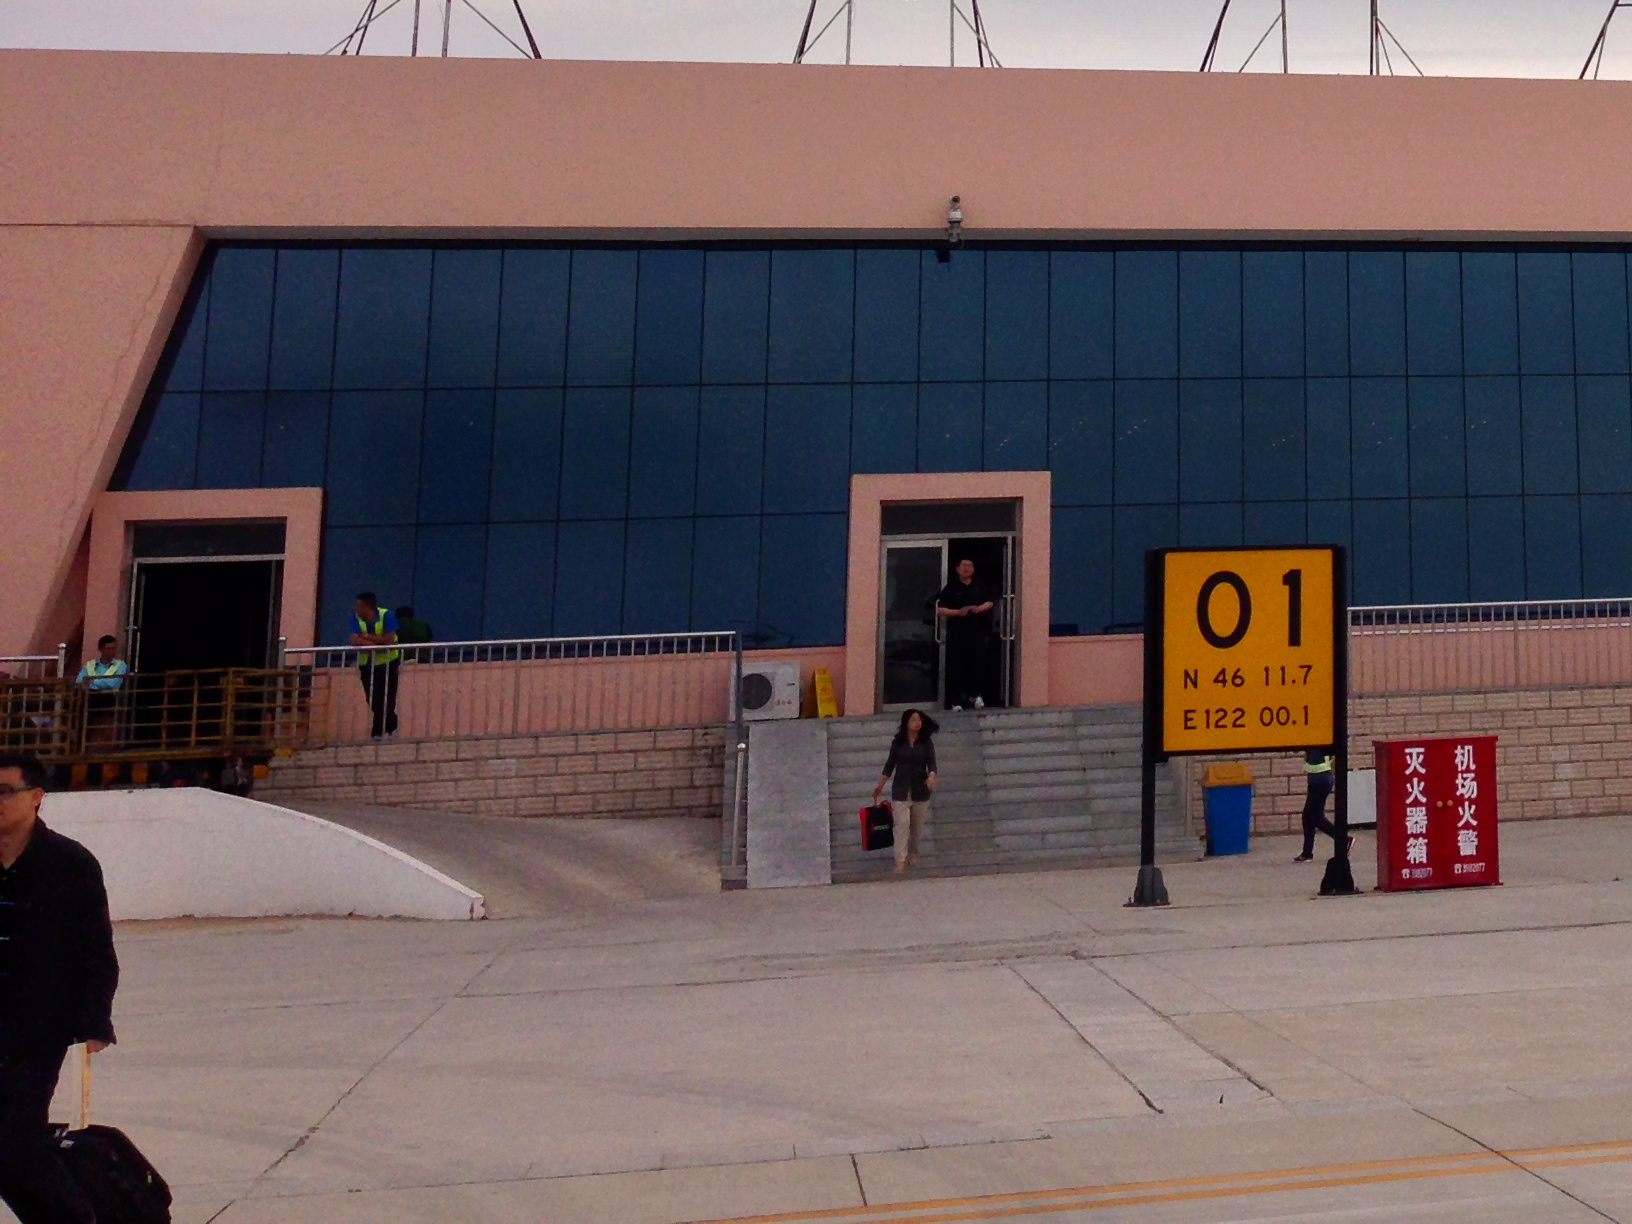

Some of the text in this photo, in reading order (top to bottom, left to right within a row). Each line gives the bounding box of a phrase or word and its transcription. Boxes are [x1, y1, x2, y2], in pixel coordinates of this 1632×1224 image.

[1197, 569, 1302, 649] 01
[1183, 665, 1313, 690] N 46 11.7
[1259, 706, 1309, 727] 00.1
[1404, 747, 1428, 864] 灭火器箱
[1454, 745, 1478, 856] 机场火警
